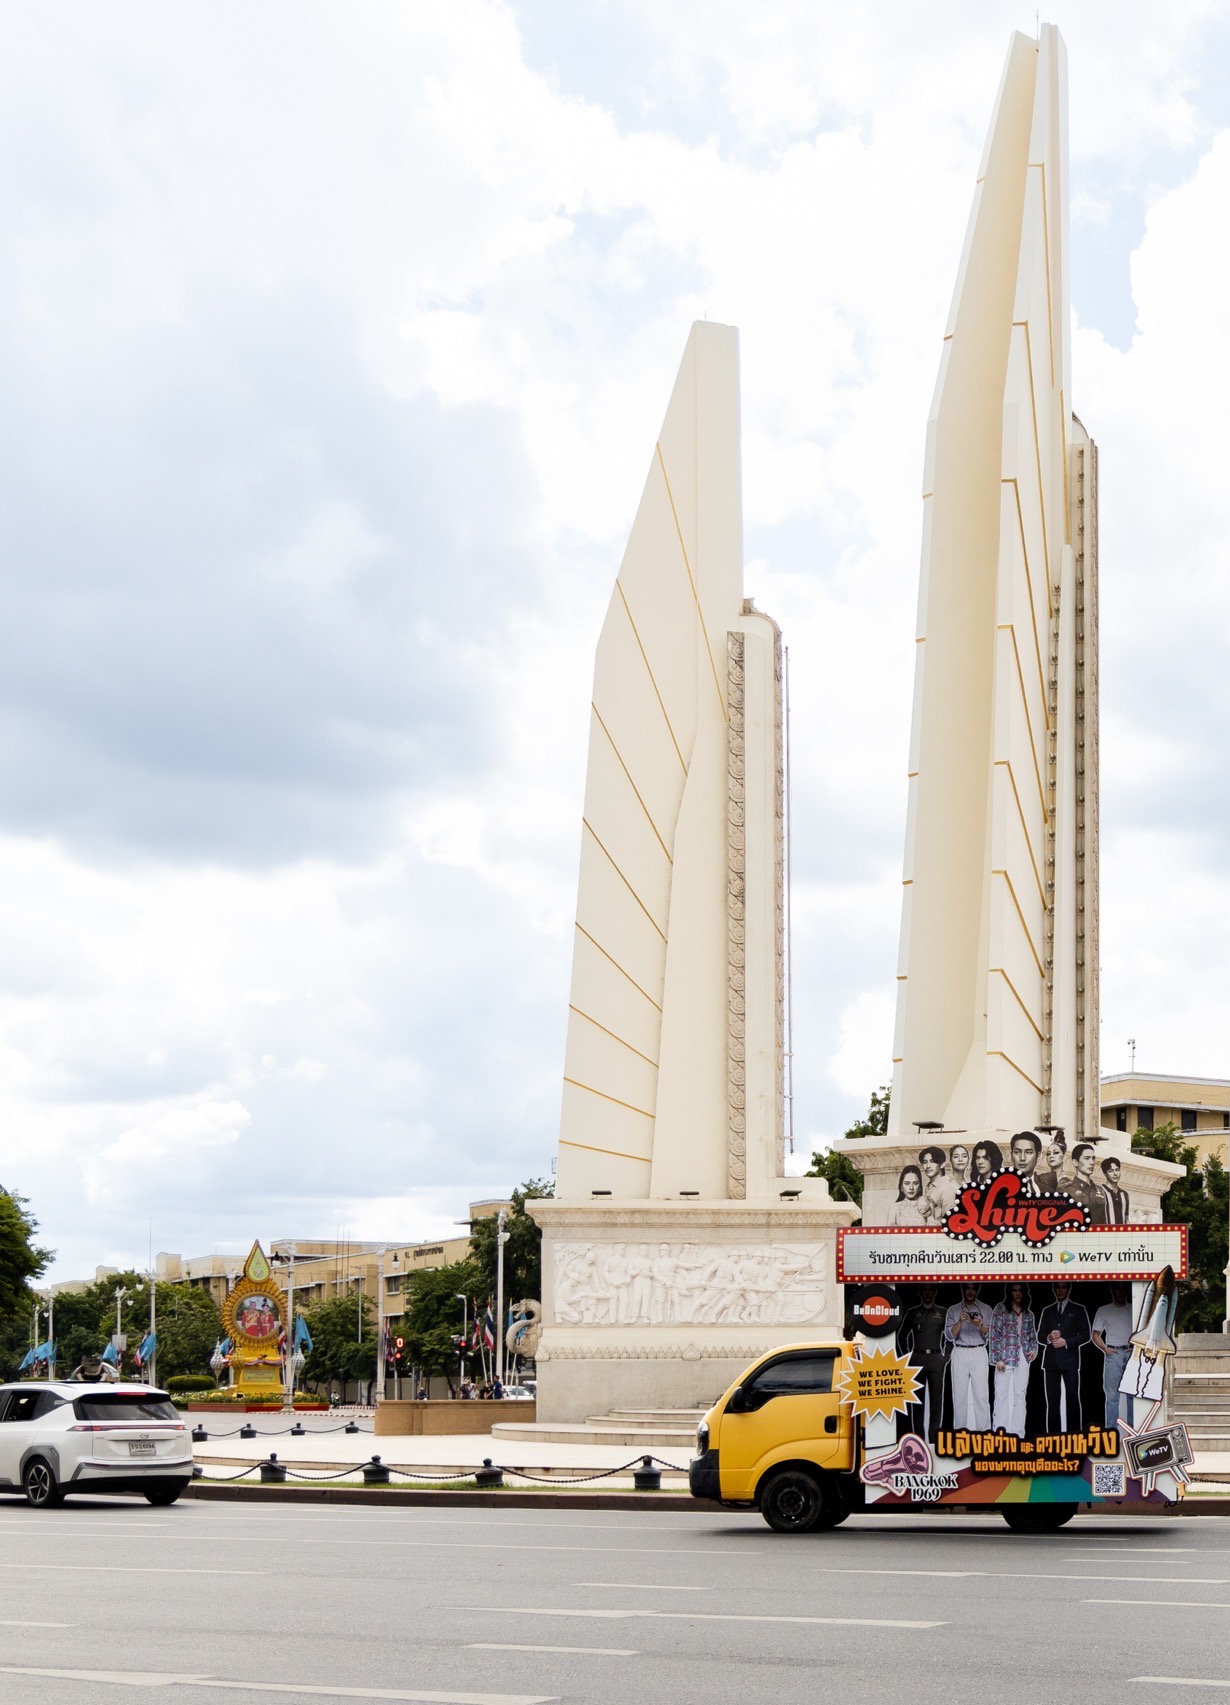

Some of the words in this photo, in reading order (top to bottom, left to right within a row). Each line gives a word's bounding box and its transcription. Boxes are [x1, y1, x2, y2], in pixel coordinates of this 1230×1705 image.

[948, 1173, 1084, 1241] Shine
[869, 1249, 976, 1267] รับชมทุกคืนวันเสาร์
[979, 1251, 1013, 1263] 22.00
[1016, 1252, 1028, 1263] น.
[1031, 1252, 1053, 1263] ทาง
[1078, 1252, 1113, 1262] WeTV
[1118, 1244, 1154, 1262] เท่านั้น
[853, 1304, 900, 1316] BeOnCloud
[859, 1370, 874, 1378] WE
[876, 1369, 903, 1377] LOVE.
[875, 1378, 906, 1386] FIGHT.
[858, 1389, 873, 1397] WE
[875, 1387, 907, 1395] SHINE.
[937, 1429, 1017, 1458] แสงสว่าง
[1020, 1441, 1035, 1454] และ
[1036, 1425, 1117, 1458] ความหวัง
[1148, 1445, 1169, 1456] WeTV
[974, 1458, 1080, 1474] ของพวกคุณคืออะไร?
[894, 1474, 958, 1488] BANGKOK
[912, 1487, 941, 1500] 1969
